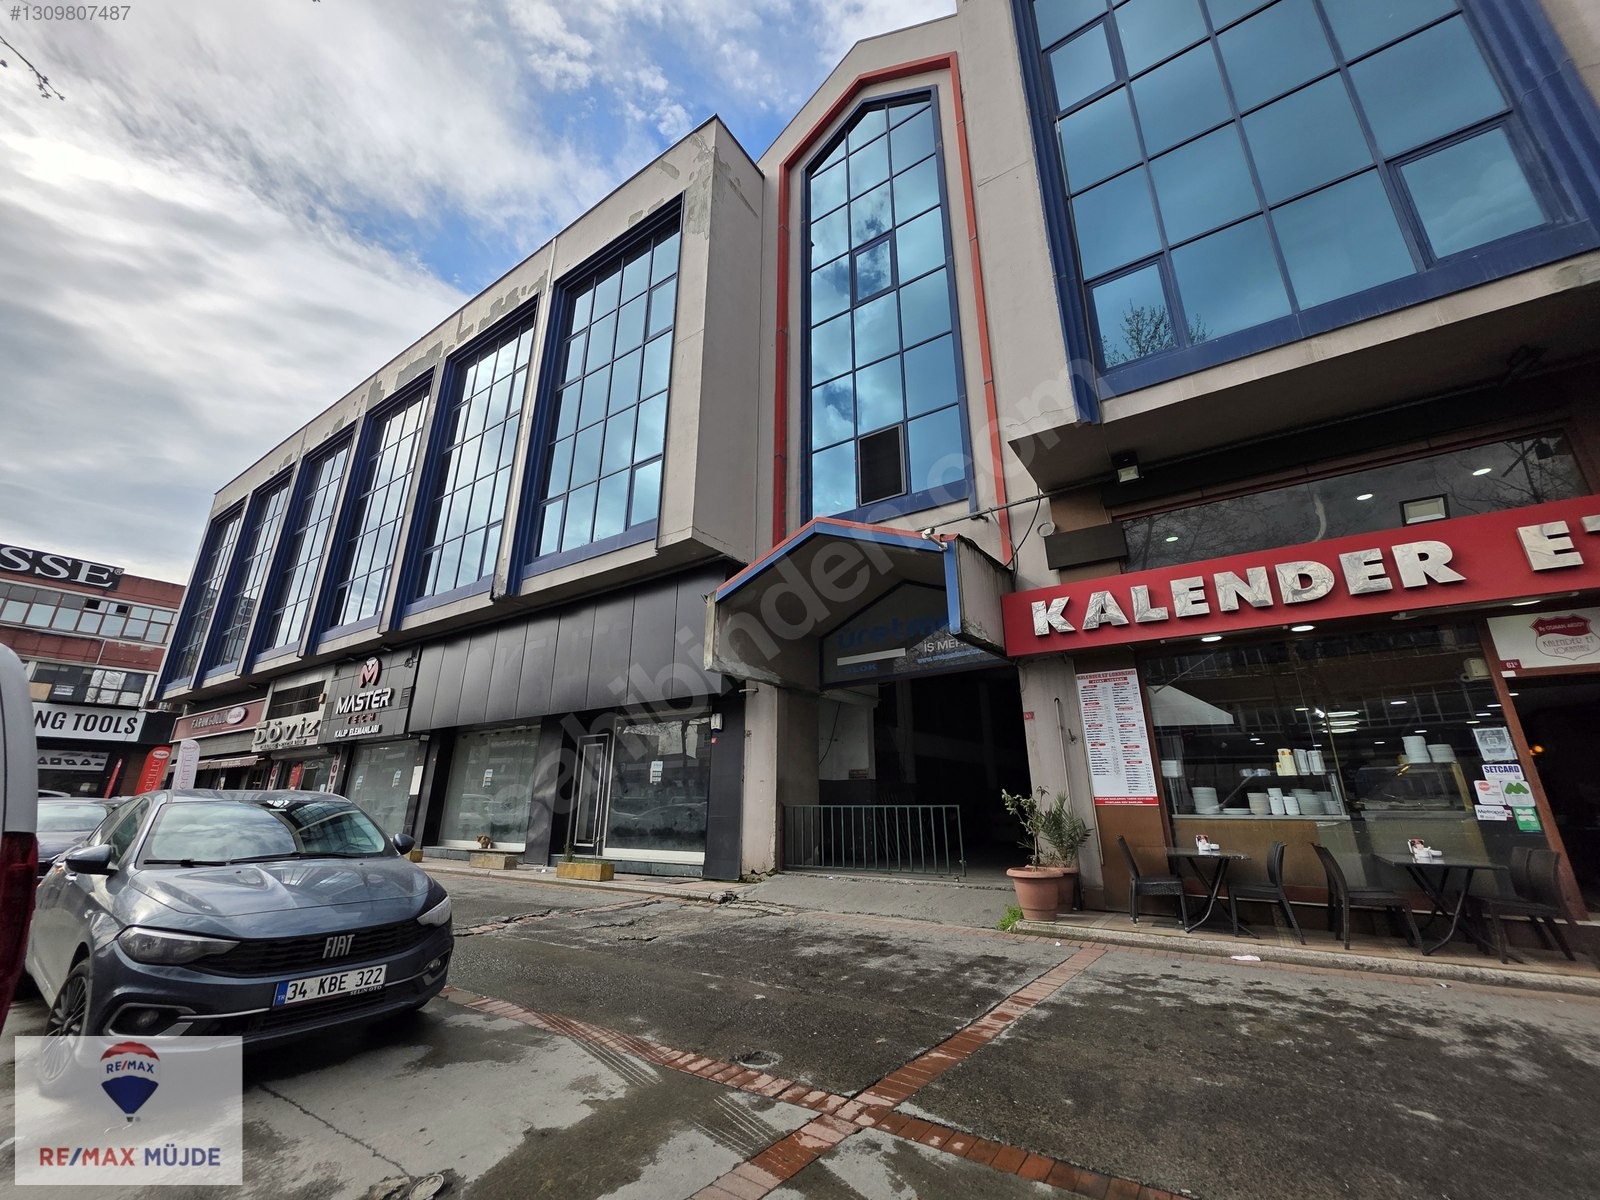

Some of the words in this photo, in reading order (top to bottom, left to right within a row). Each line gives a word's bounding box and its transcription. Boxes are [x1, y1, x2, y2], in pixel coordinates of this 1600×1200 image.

[1031, 540, 1466, 637] KALENDER
[336, 687, 392, 714] MASTER
[73, 713, 138, 735] TOOLS
[253, 716, 321, 746] DÖVİZ
[334, 728, 348, 738] KALIP
[348, 724, 380, 736] ELEMANLARI
[347, 713, 376, 724] TECH
[1484, 765, 1520, 774] SETCARD
[322, 934, 355, 959] FIAT
[287, 983, 307, 1001] 34
[317, 974, 349, 995] KBE
[355, 967, 383, 988] 322
